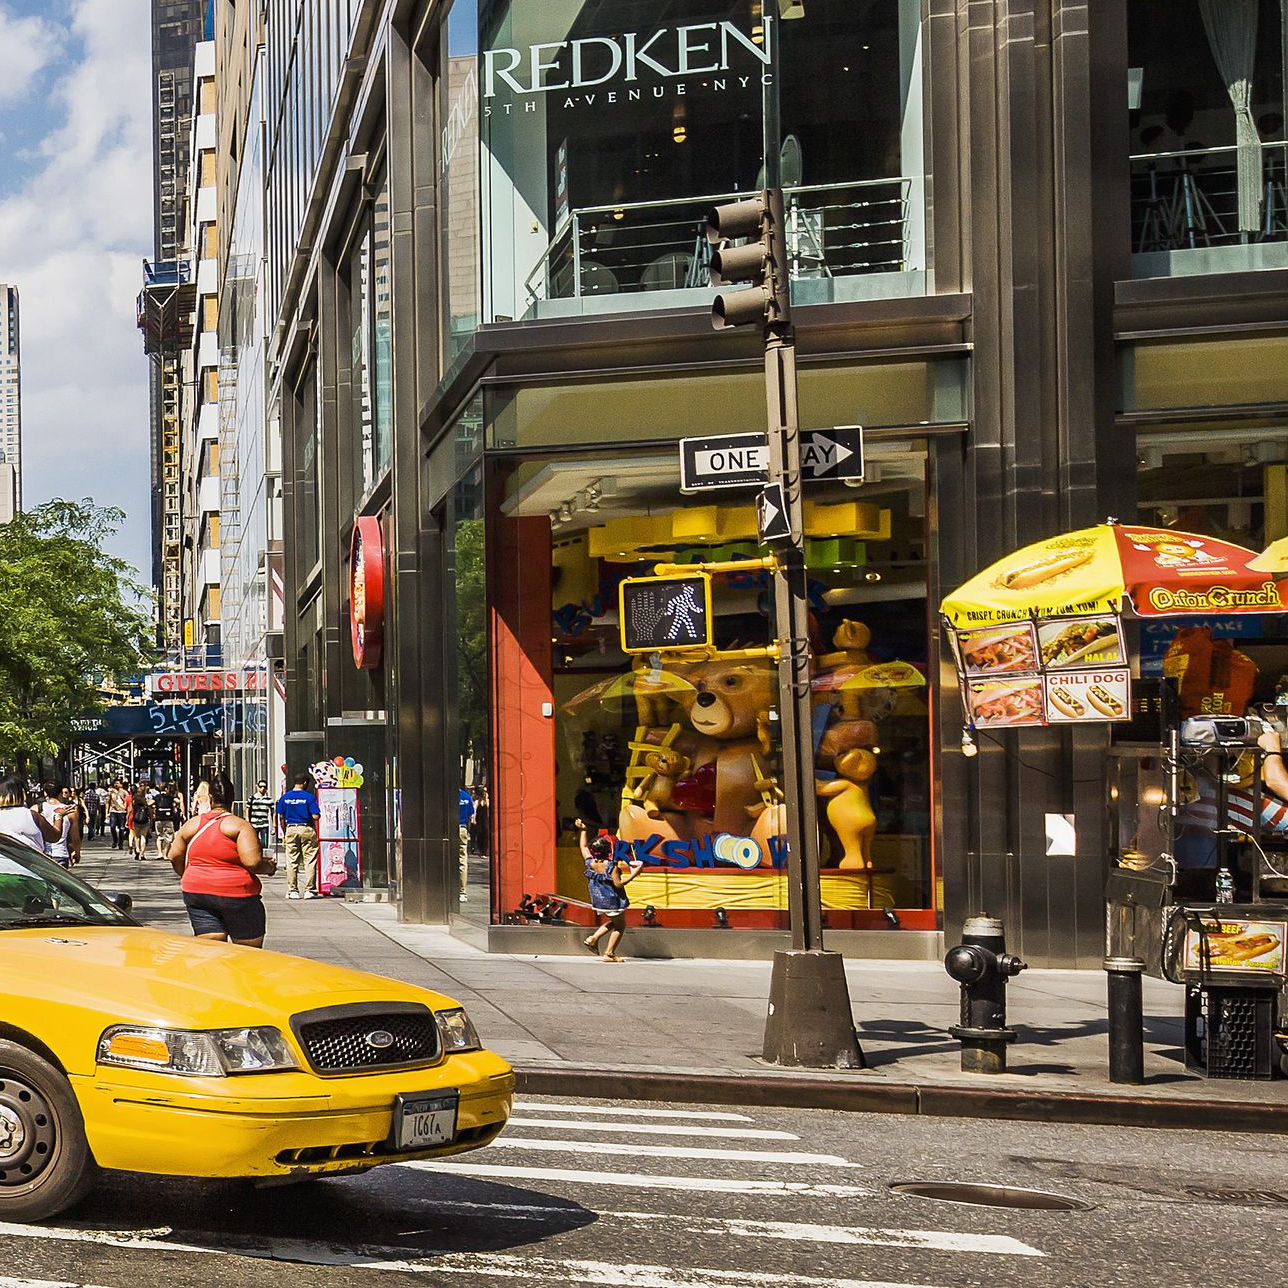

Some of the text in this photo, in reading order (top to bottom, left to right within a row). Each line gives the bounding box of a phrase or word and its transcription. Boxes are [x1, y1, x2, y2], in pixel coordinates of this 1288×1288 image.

[483, 15, 773, 98] REDKEN
[484, 73, 773, 117] 5TH AVENUE NYC
[710, 444, 836, 471] ONE AY
[157, 673, 238, 691] GUESS
[1049, 673, 1125, 685] CHILI DOG
[1221, 924, 1242, 934] BEEF
[413, 1113, 441, 1138] 1C67A
